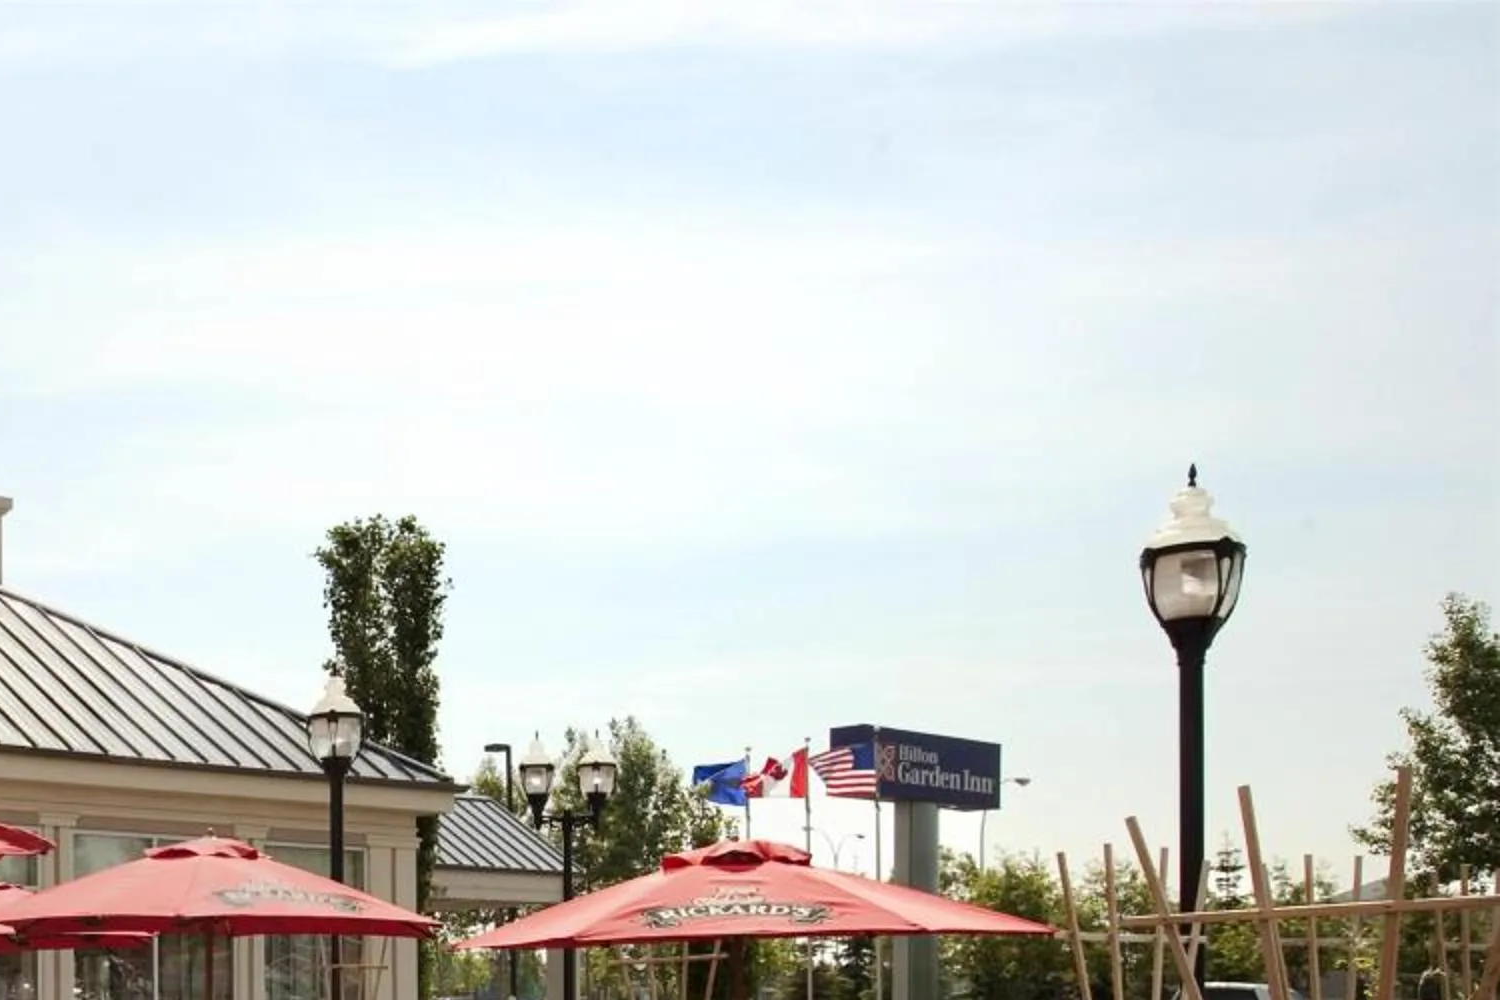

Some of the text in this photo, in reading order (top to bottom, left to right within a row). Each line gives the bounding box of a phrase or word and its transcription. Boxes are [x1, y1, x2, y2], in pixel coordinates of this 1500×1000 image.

[899, 743, 939, 765] Hilton
[897, 761, 993, 795] Garden Inn
[658, 903, 811, 920] RICKARD'S
